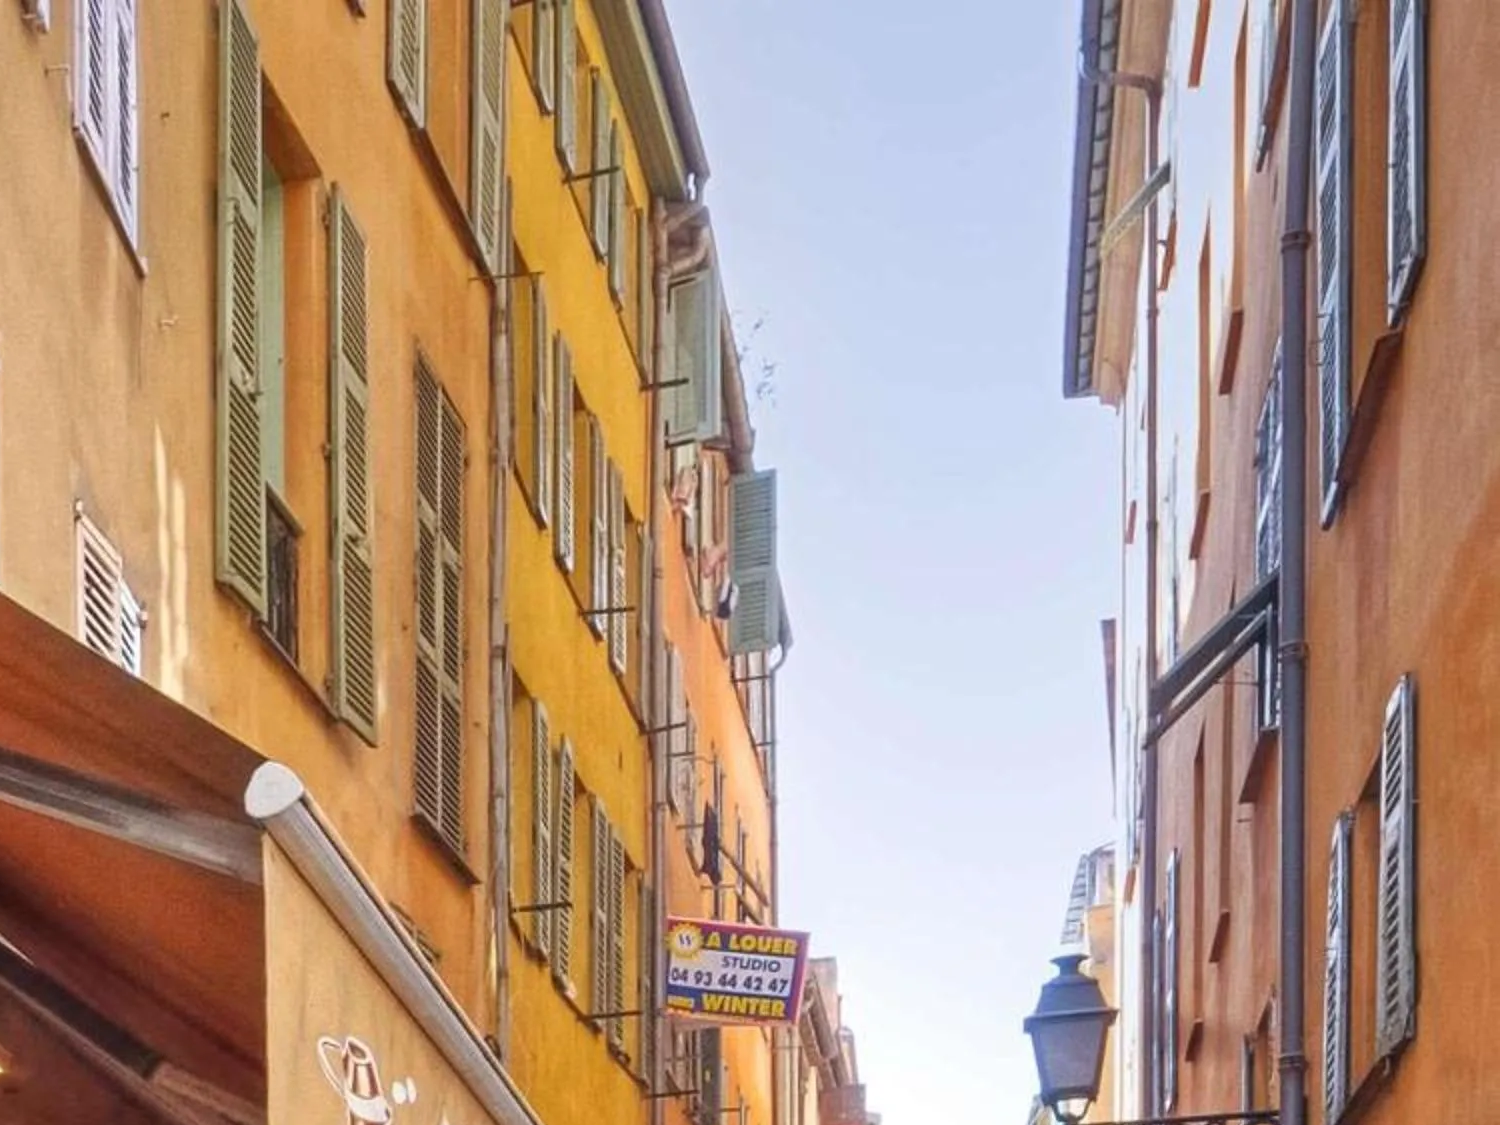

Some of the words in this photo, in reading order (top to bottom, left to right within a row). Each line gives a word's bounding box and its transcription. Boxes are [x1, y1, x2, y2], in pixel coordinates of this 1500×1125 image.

[705, 931, 722, 948] A
[728, 933, 798, 955] LOUER
[721, 955, 782, 973] STUDIO
[671, 966, 688, 982] 04
[694, 969, 713, 986] 93
[718, 972, 737, 989] 44
[743, 975, 763, 991] 42
[768, 978, 789, 994] 47
[701, 992, 786, 1017] WINTER
